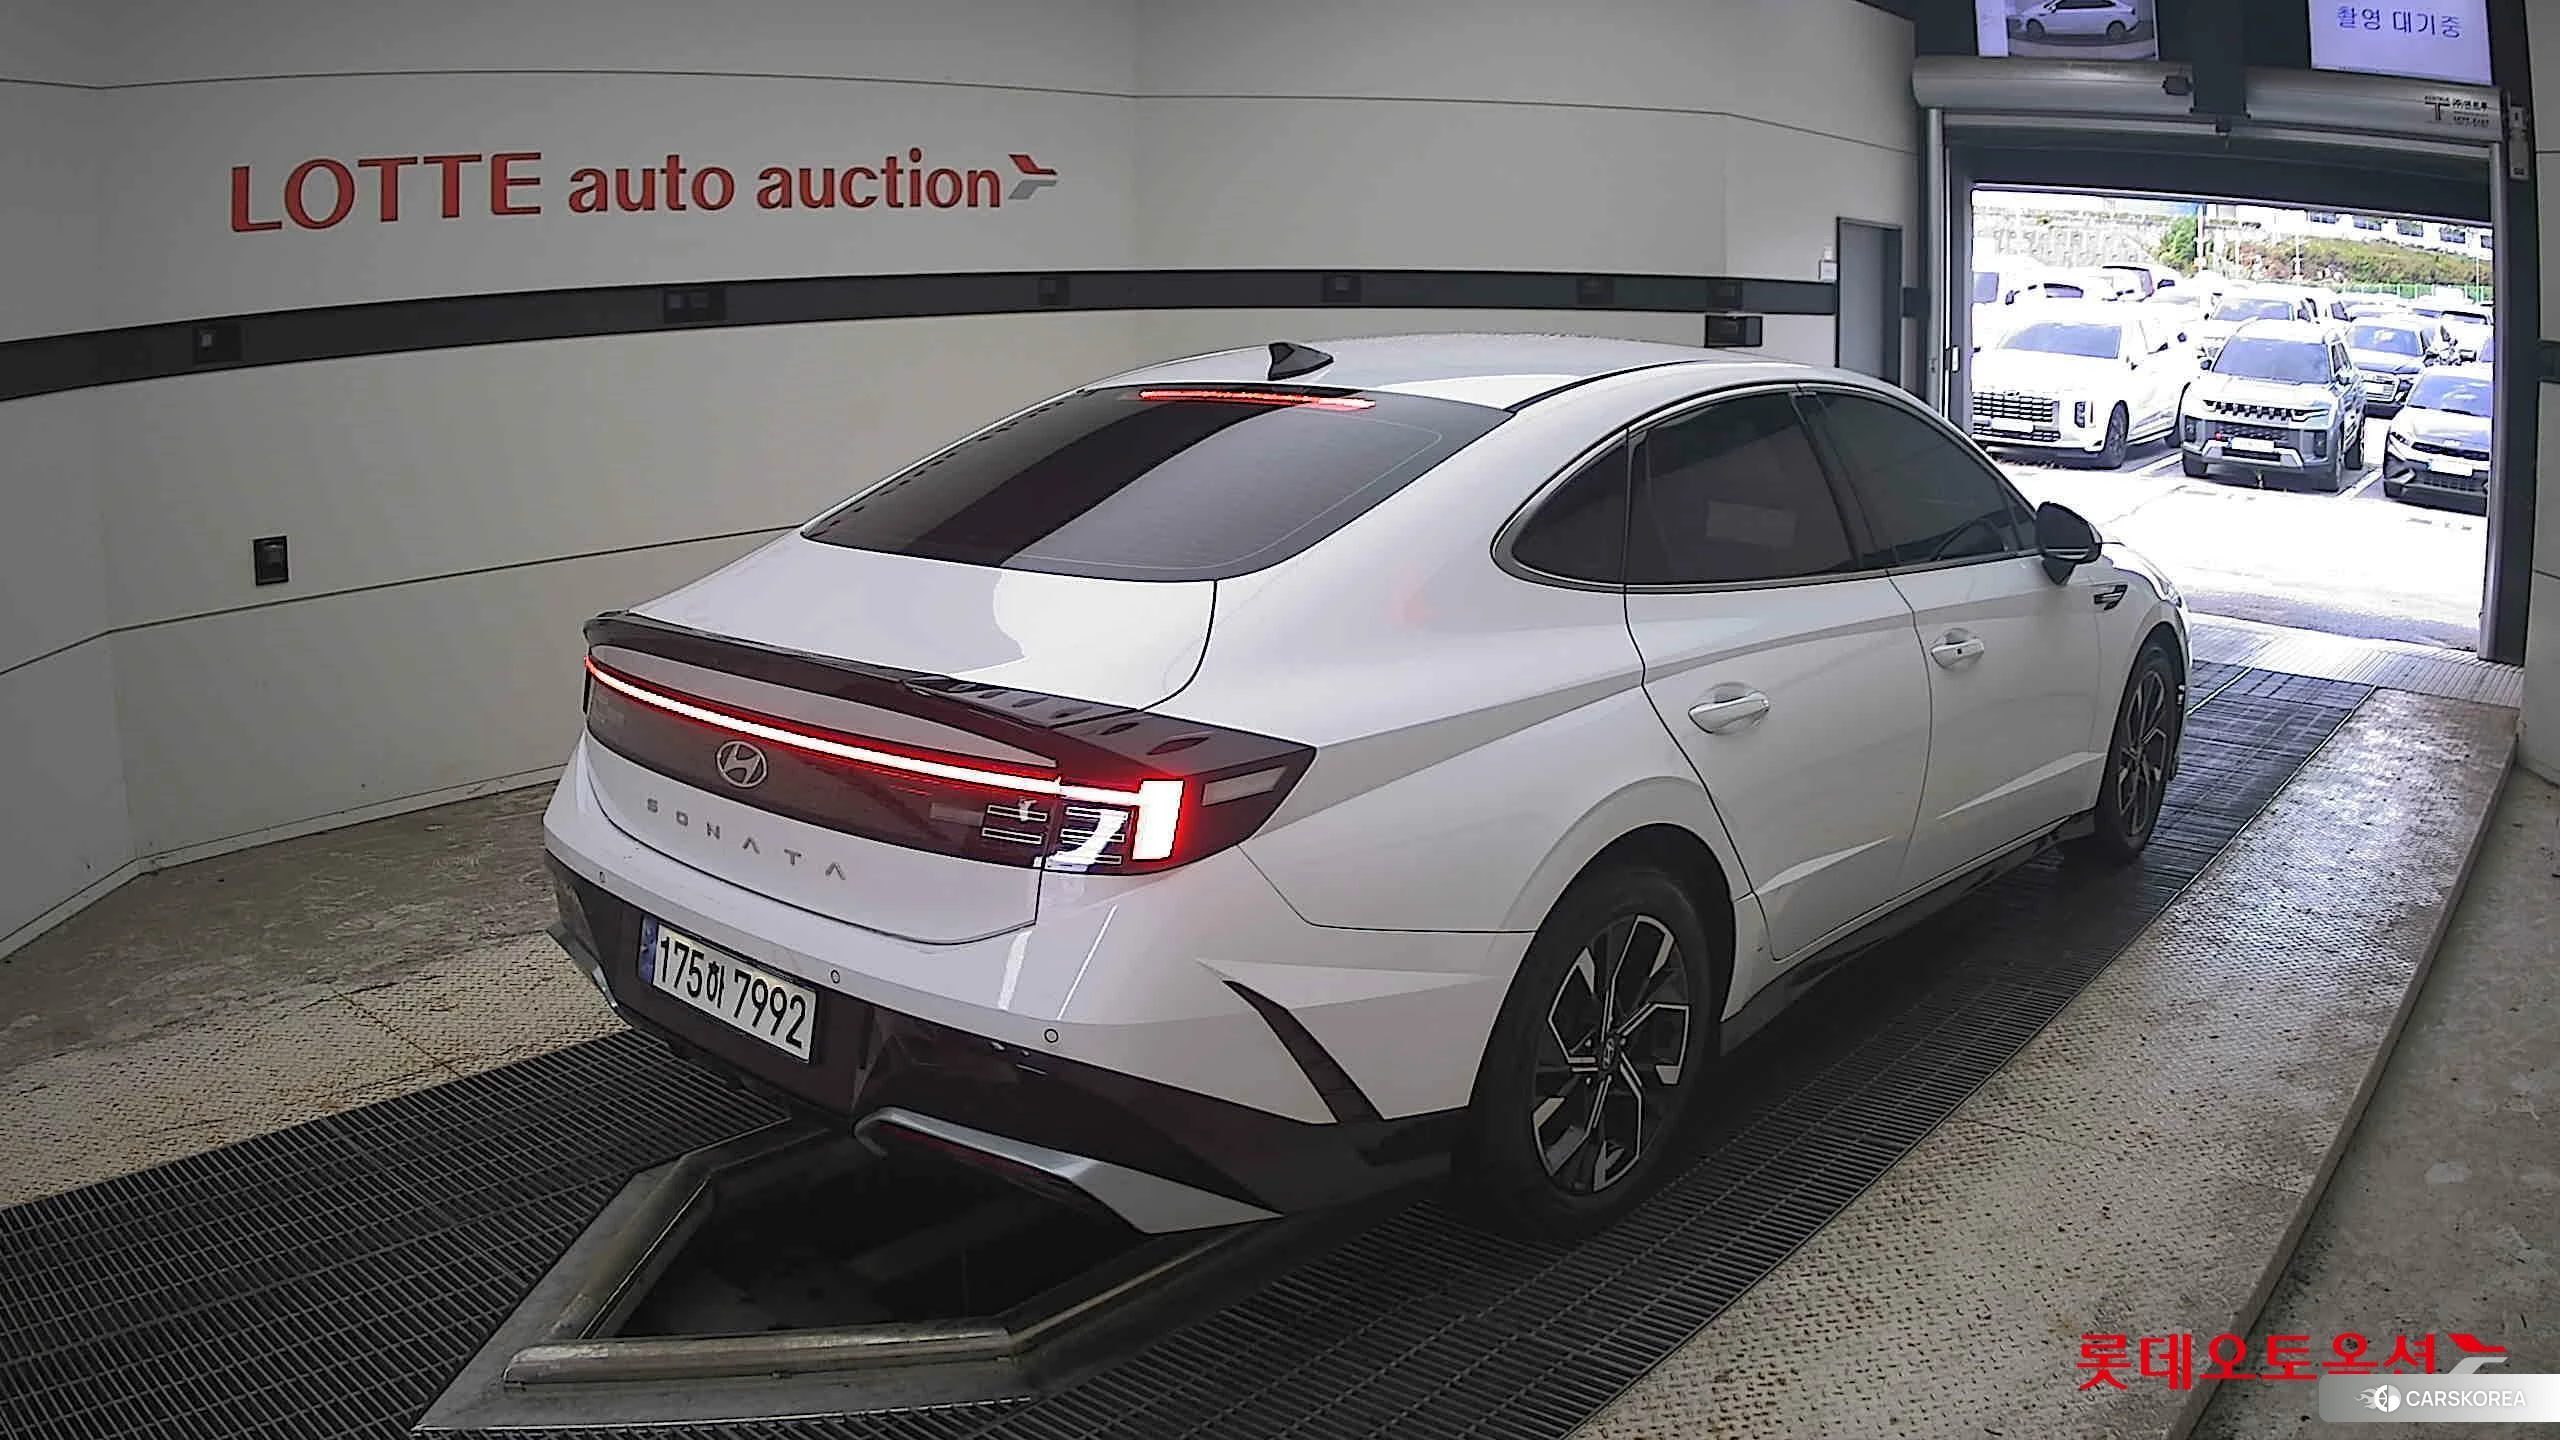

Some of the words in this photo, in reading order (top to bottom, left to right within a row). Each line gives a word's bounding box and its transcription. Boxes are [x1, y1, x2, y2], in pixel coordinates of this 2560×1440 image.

[2337, 6, 2381, 31] 촬영
[2392, 10, 2461, 39] 대기중
[231, 151, 542, 233] LOTTE
[568, 153, 735, 214] auto
[756, 147, 1001, 210] auction
[647, 797, 846, 881] SONATA
[660, 935, 725, 1010] 175하
[733, 967, 807, 1050] 7992
